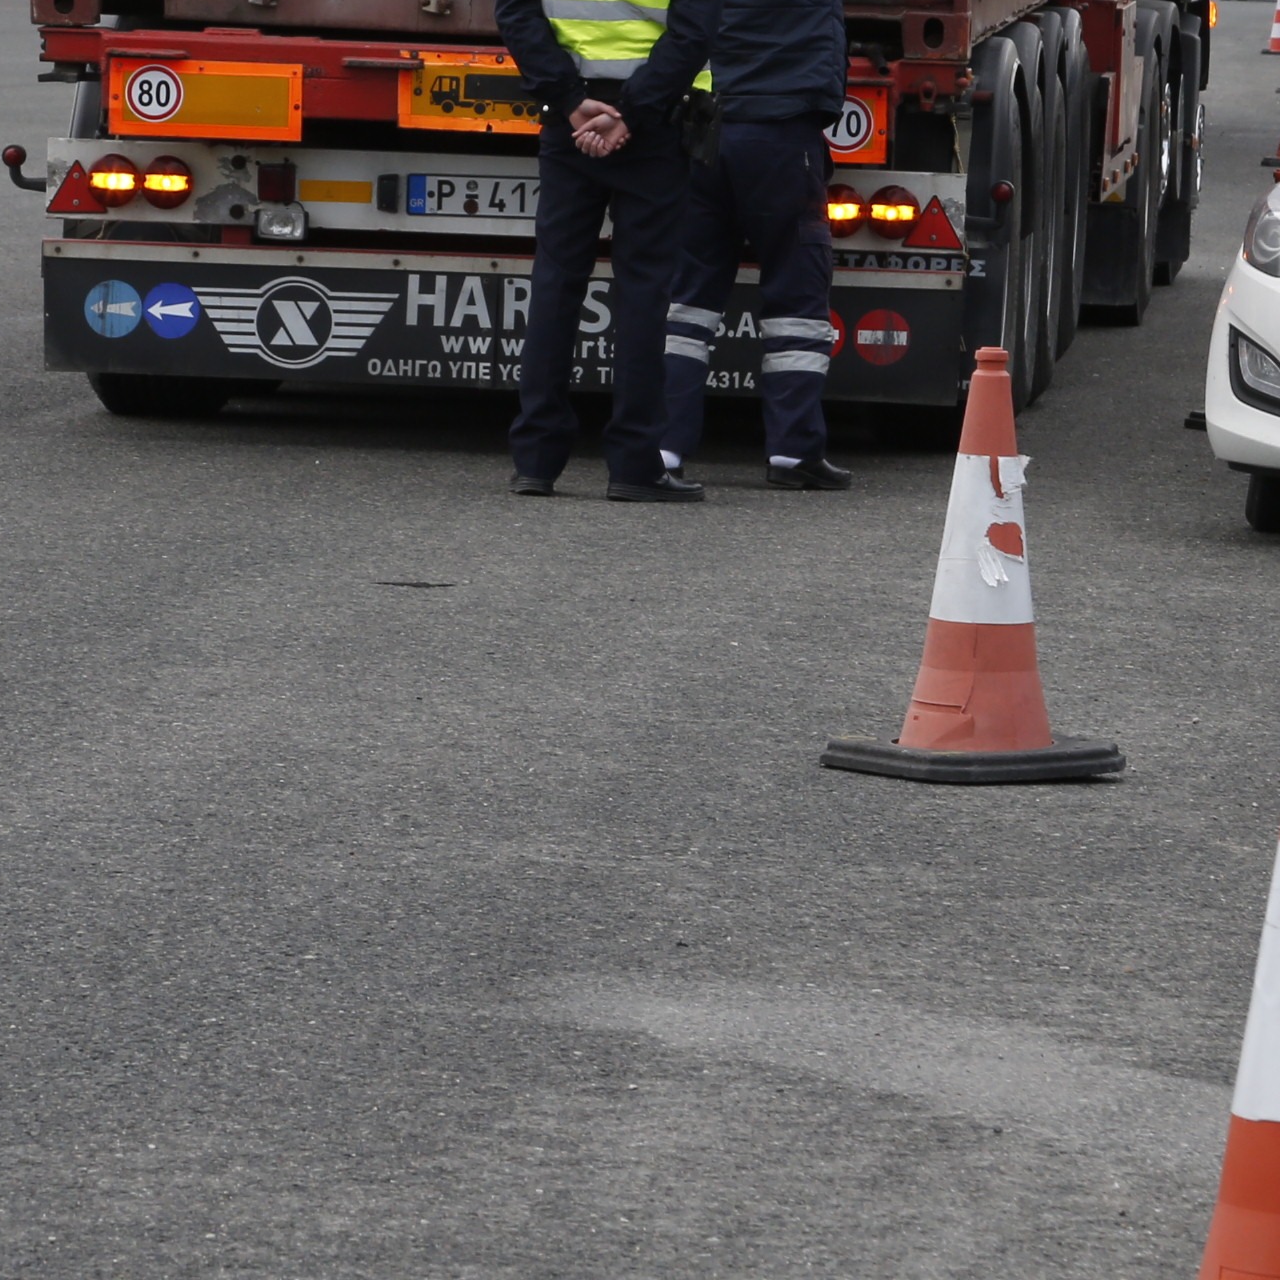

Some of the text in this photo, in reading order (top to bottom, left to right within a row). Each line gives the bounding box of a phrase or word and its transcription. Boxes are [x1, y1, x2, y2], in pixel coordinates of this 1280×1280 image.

[137, 79, 171, 107] 80
[832, 253, 986, 277] ΕΤΑΦΟΡΕΣ
[367, 358, 442, 377] ΟΔΗΓΩ
